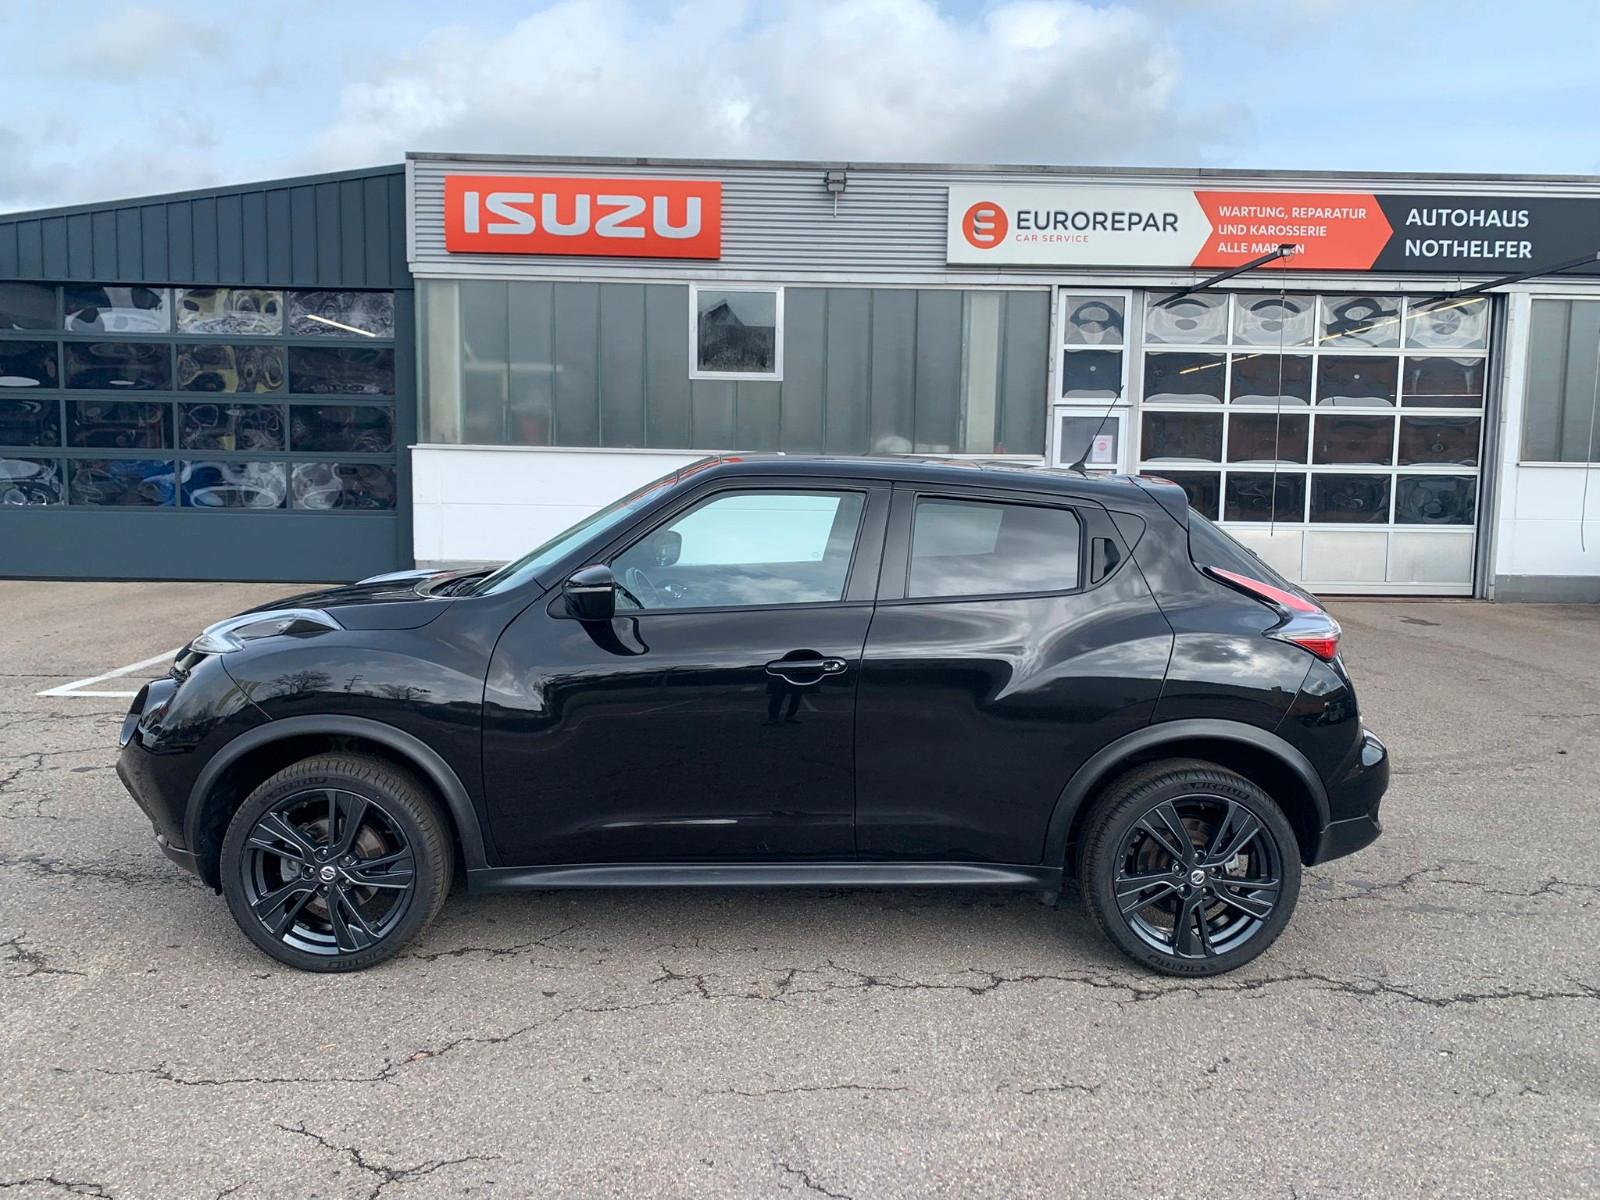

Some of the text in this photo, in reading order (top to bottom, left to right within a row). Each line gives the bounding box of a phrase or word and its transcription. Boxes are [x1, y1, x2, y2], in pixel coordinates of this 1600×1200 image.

[463, 191, 702, 239] ISUZU
[1016, 210, 1178, 232] EUROREPAR
[1218, 206, 1367, 220] WARTUNG, REPARATUR
[1405, 208, 1530, 228] AUTOHAUS
[1015, 234, 1089, 244] CAR SERVICE
[1218, 224, 1327, 237] UND KAROSSERIE
[1217, 242, 1305, 255] ALLE MARN
[1405, 239, 1532, 259] NOTHELFER
